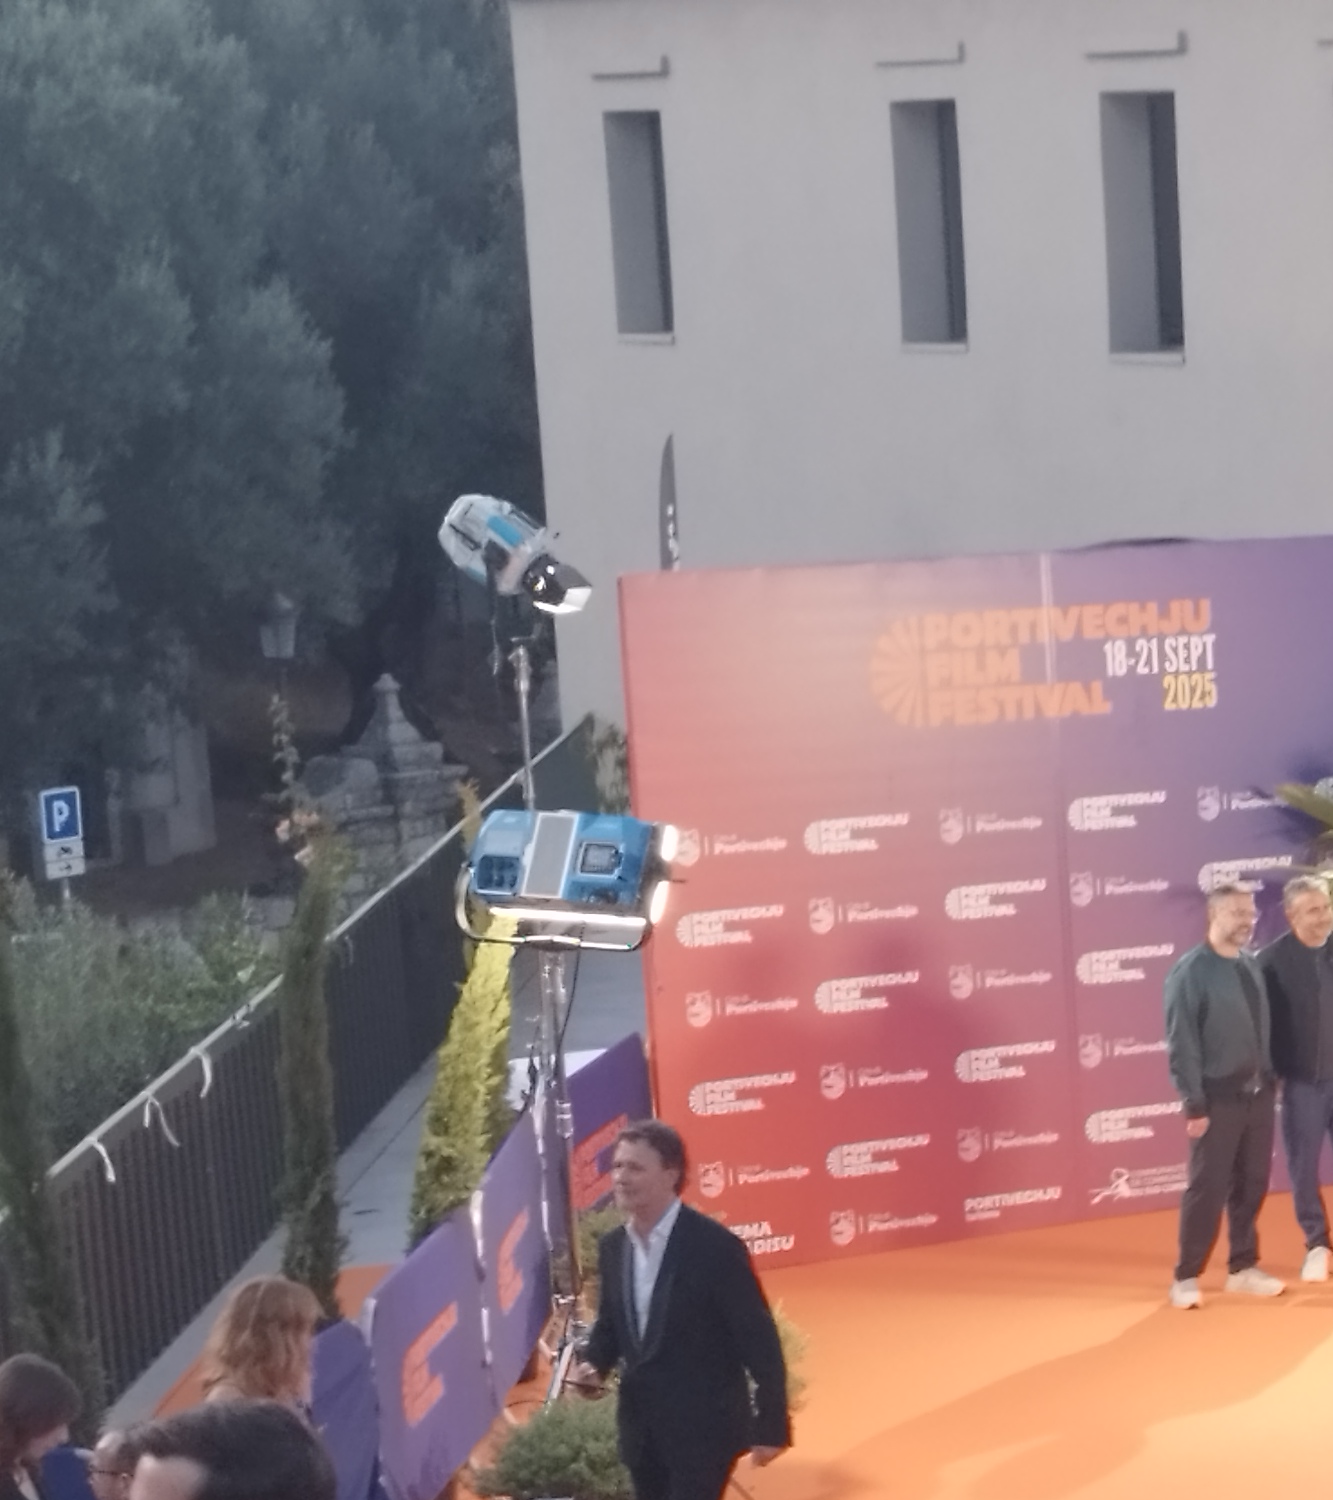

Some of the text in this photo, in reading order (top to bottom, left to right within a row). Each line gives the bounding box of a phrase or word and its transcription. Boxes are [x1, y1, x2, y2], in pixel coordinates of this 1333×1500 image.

[923, 598, 1211, 649] PORTIVECHJU
[925, 646, 1021, 688] FILM
[1103, 633, 1216, 677] 18-21 SEPT
[927, 680, 1112, 728] FESTIVAL
[1162, 672, 1218, 710] 2025
[53, 800, 69, 832] P
